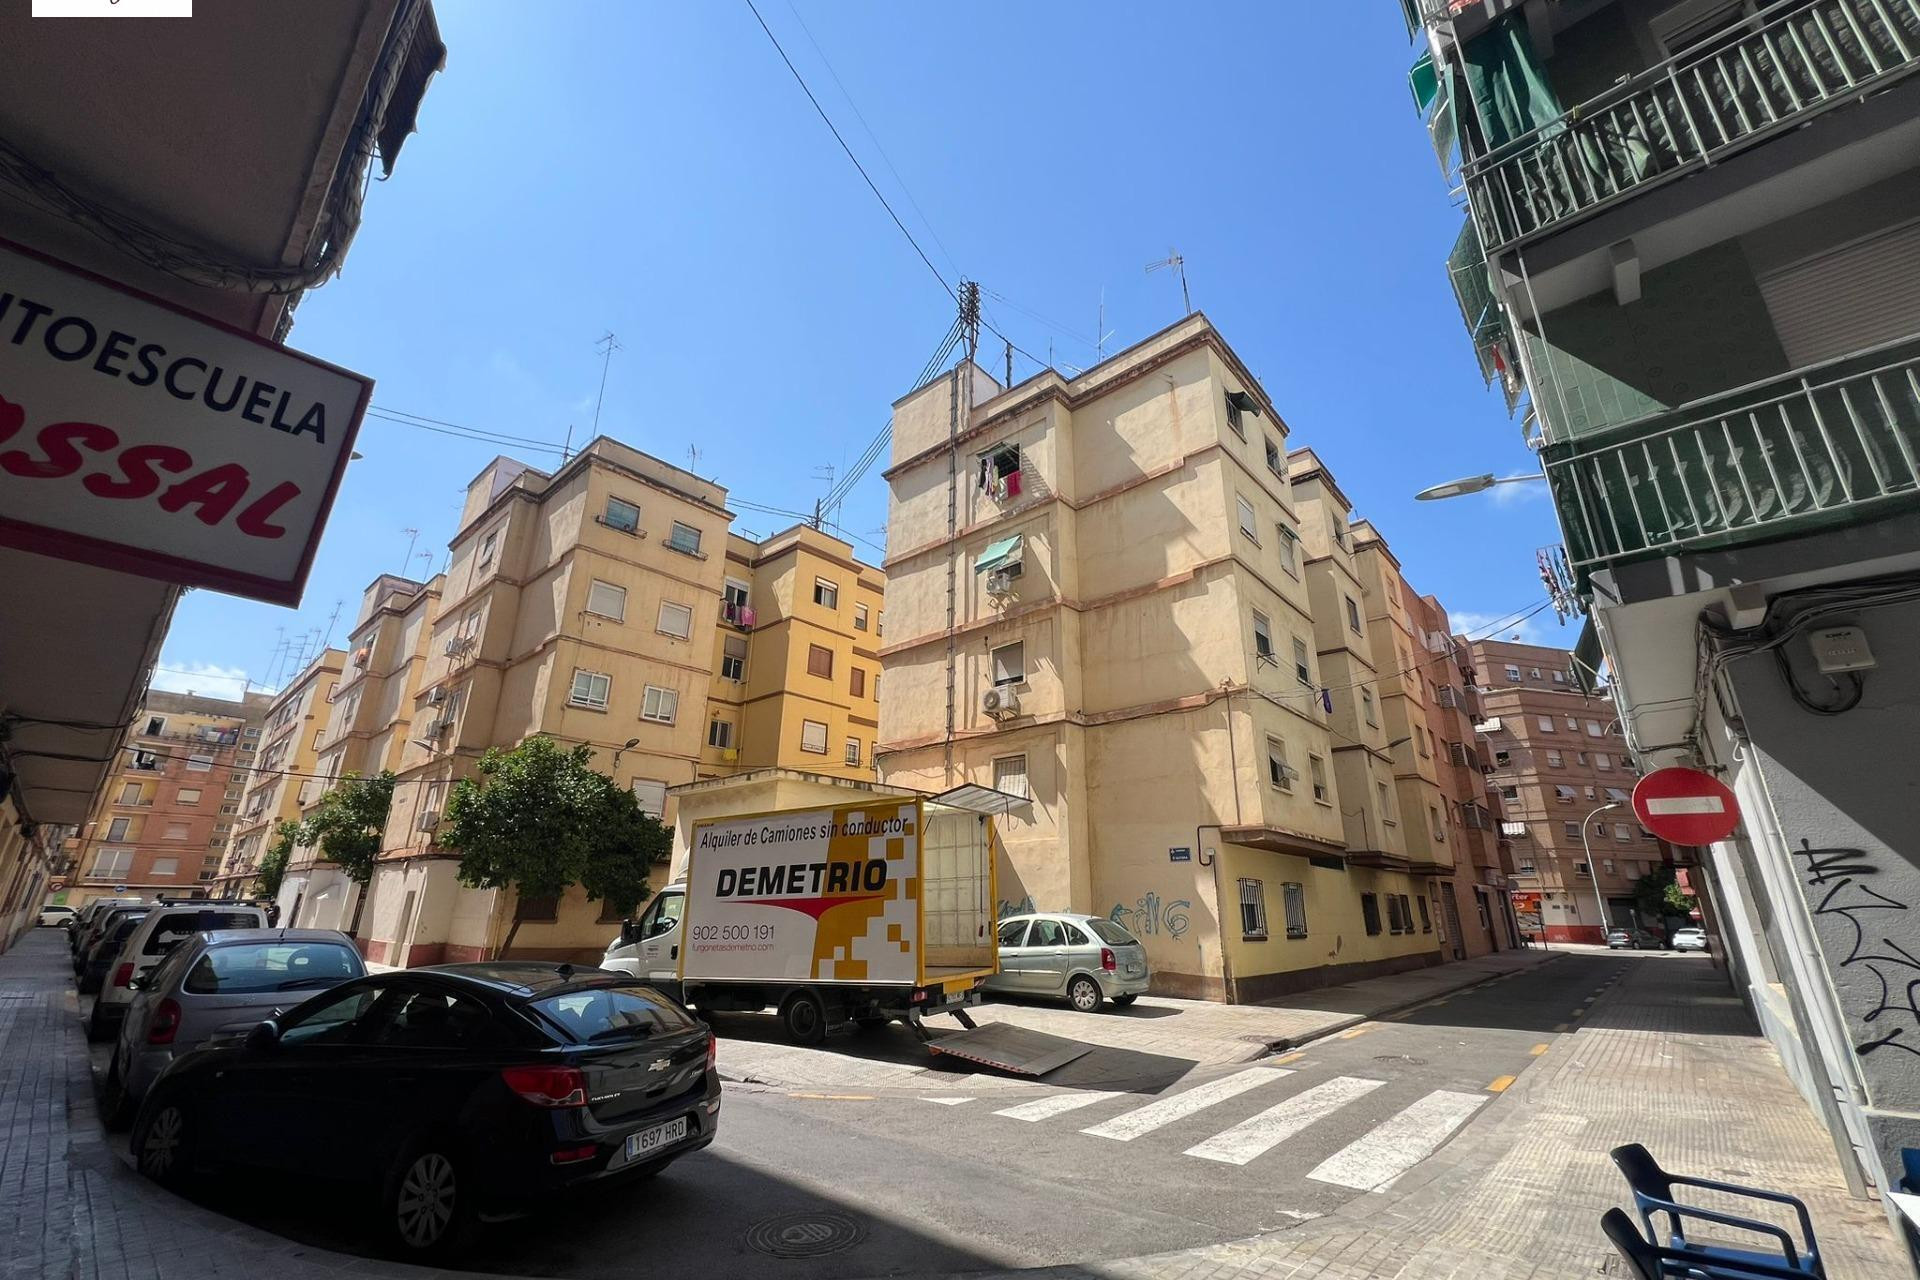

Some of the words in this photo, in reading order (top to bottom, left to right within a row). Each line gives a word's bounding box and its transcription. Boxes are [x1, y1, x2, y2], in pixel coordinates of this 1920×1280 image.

[0, 292, 326, 444] TOESCUELA
[700, 830, 742, 852] Alquiler
[744, 828, 758, 846] de
[760, 825, 816, 844] Camiones
[820, 820, 838, 839] sin
[841, 816, 909, 837] conductor
[716, 858, 888, 897] DEMETRIO
[692, 925, 719, 940] 902
[722, 925, 750, 940] 500
[753, 924, 775, 940] 191
[635, 1127, 662, 1151] 1697
[665, 1120, 684, 1141] HRD
